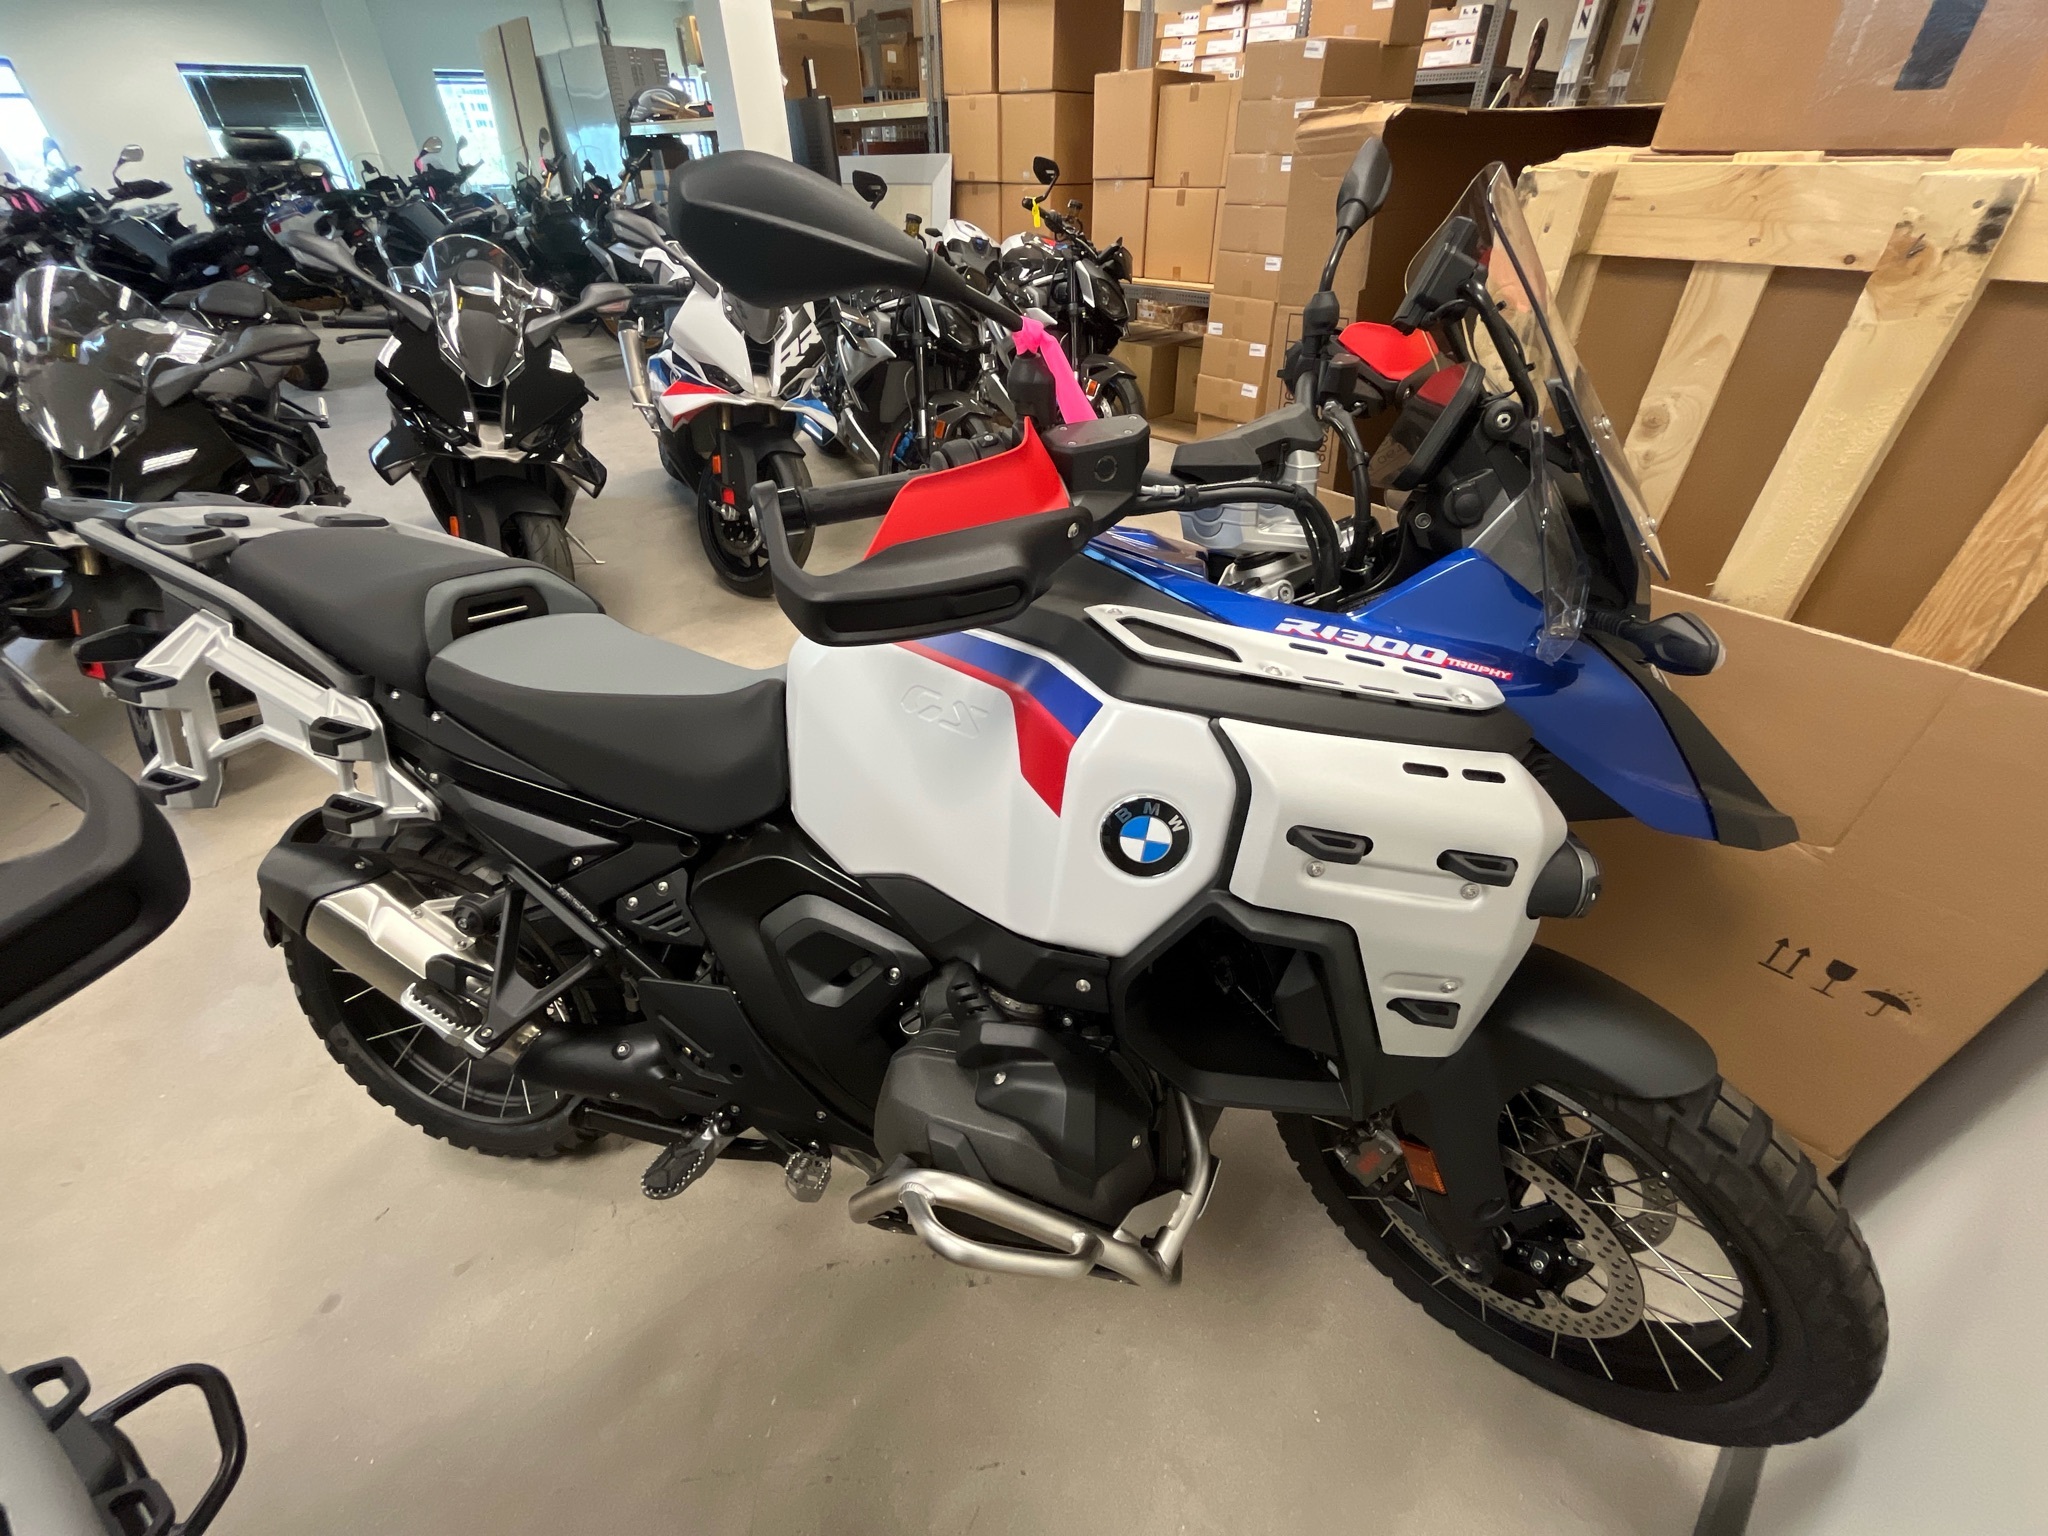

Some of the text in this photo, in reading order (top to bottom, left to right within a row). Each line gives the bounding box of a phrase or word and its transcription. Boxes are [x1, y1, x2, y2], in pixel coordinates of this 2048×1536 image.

[1447, 657, 1513, 680] TROPHY
[900, 685, 990, 740] GS
[1114, 801, 1186, 833] BMW
